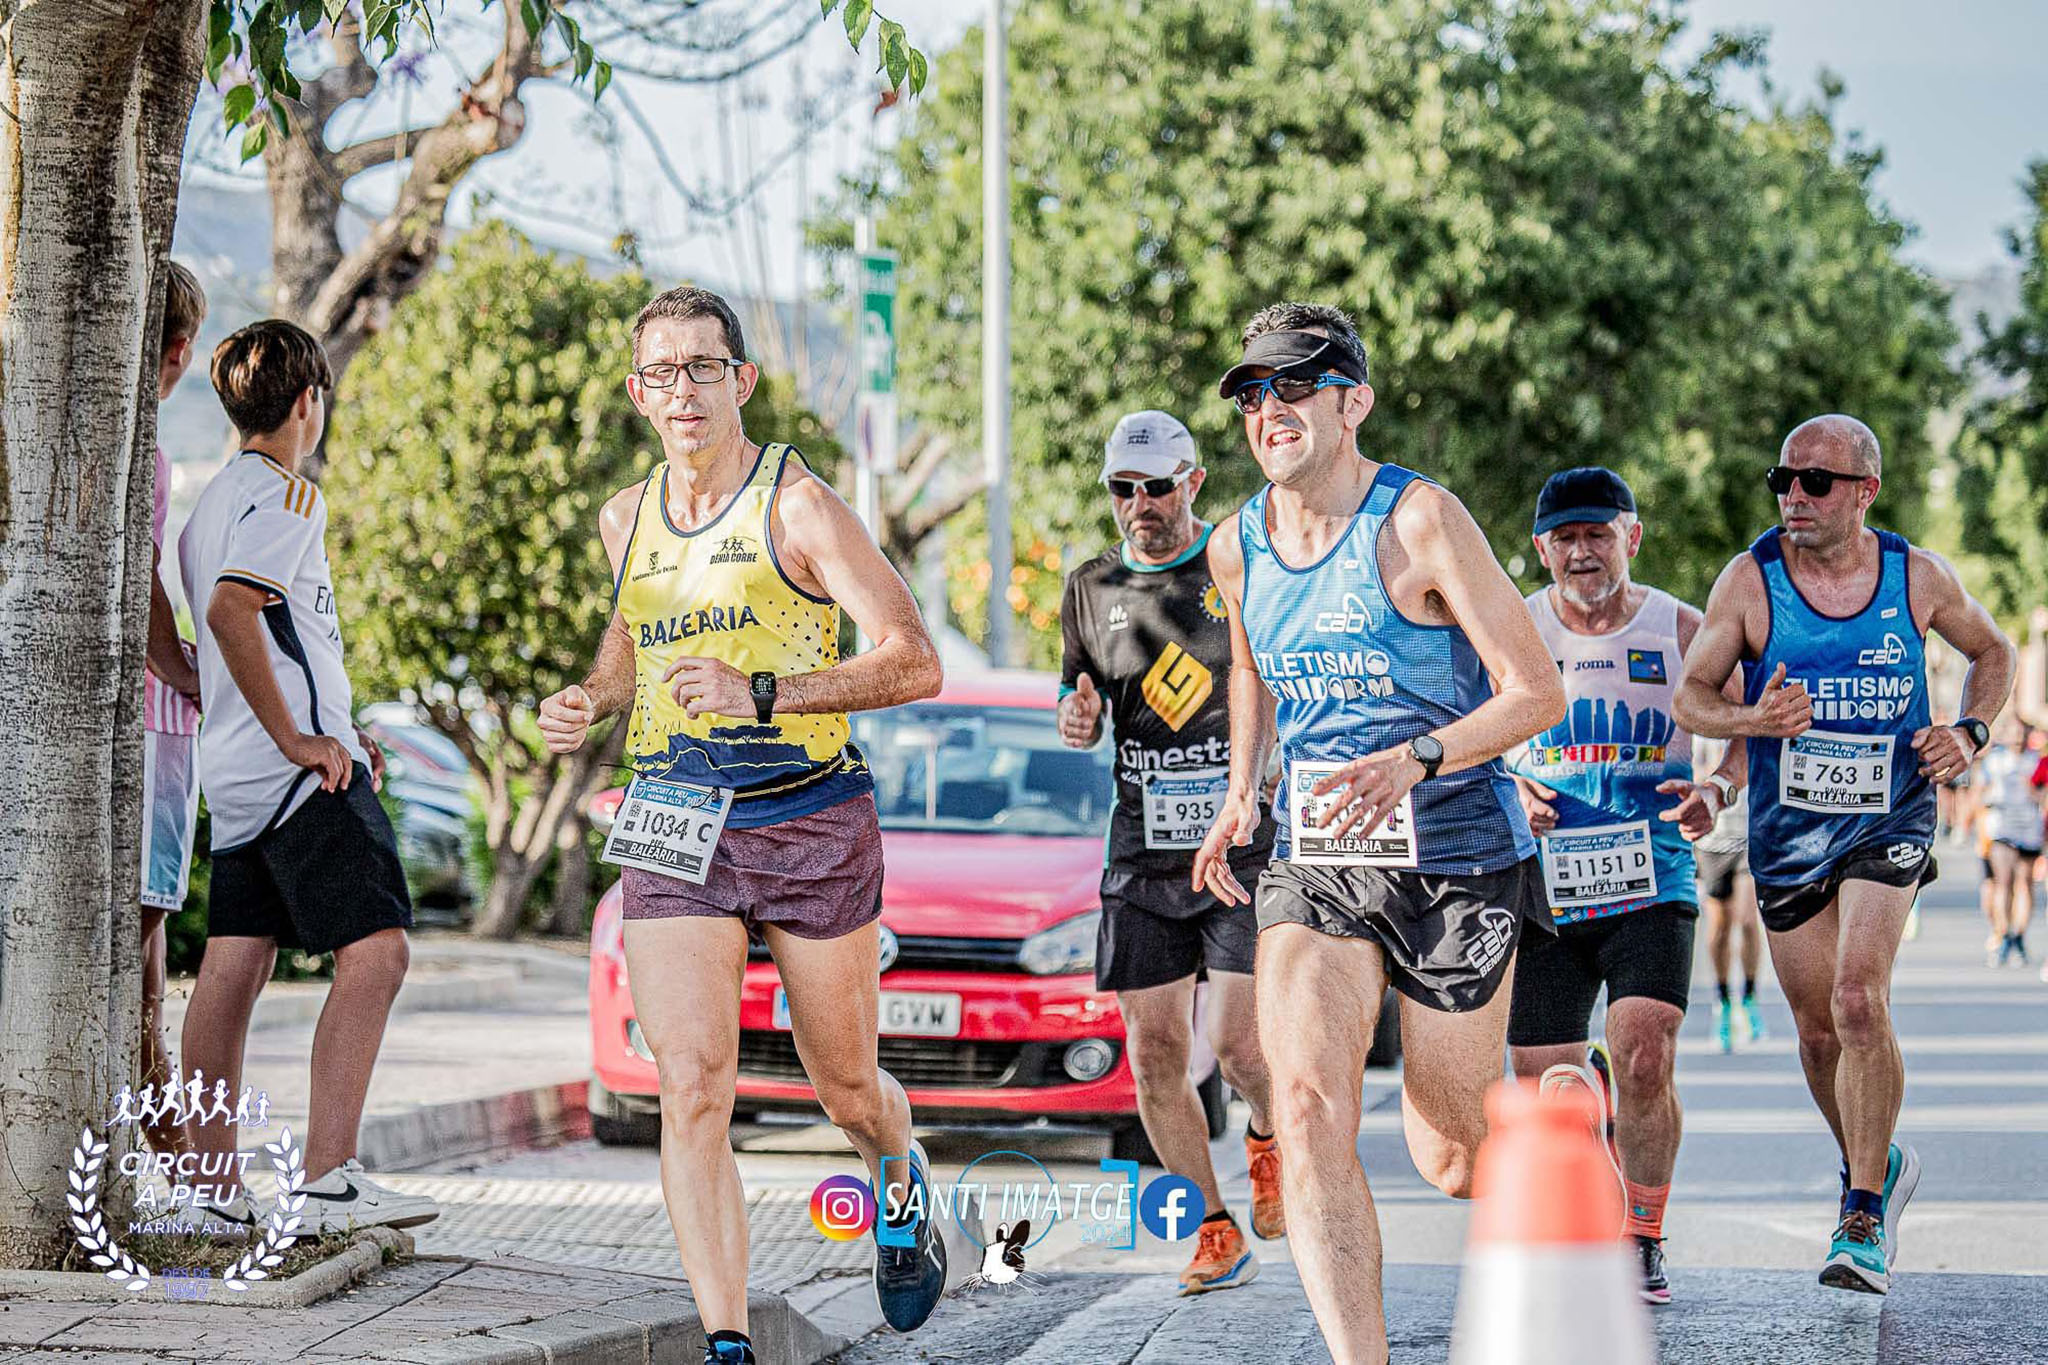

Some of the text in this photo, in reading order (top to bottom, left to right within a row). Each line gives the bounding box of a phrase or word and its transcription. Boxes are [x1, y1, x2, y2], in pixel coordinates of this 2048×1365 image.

[731, 552, 758, 563] CORRE
[1265, 675, 1395, 701] ENIDORM
[1806, 740, 1834, 751] CIRCUIT
[1841, 744, 1856, 752] PEU
[1835, 750, 1852, 758] ALTA
[1815, 763, 1884, 785] 763 B
[1176, 801, 1214, 821] 935
[641, 810, 713, 843] 1034 C
[1575, 852, 1646, 878] 1151 D
